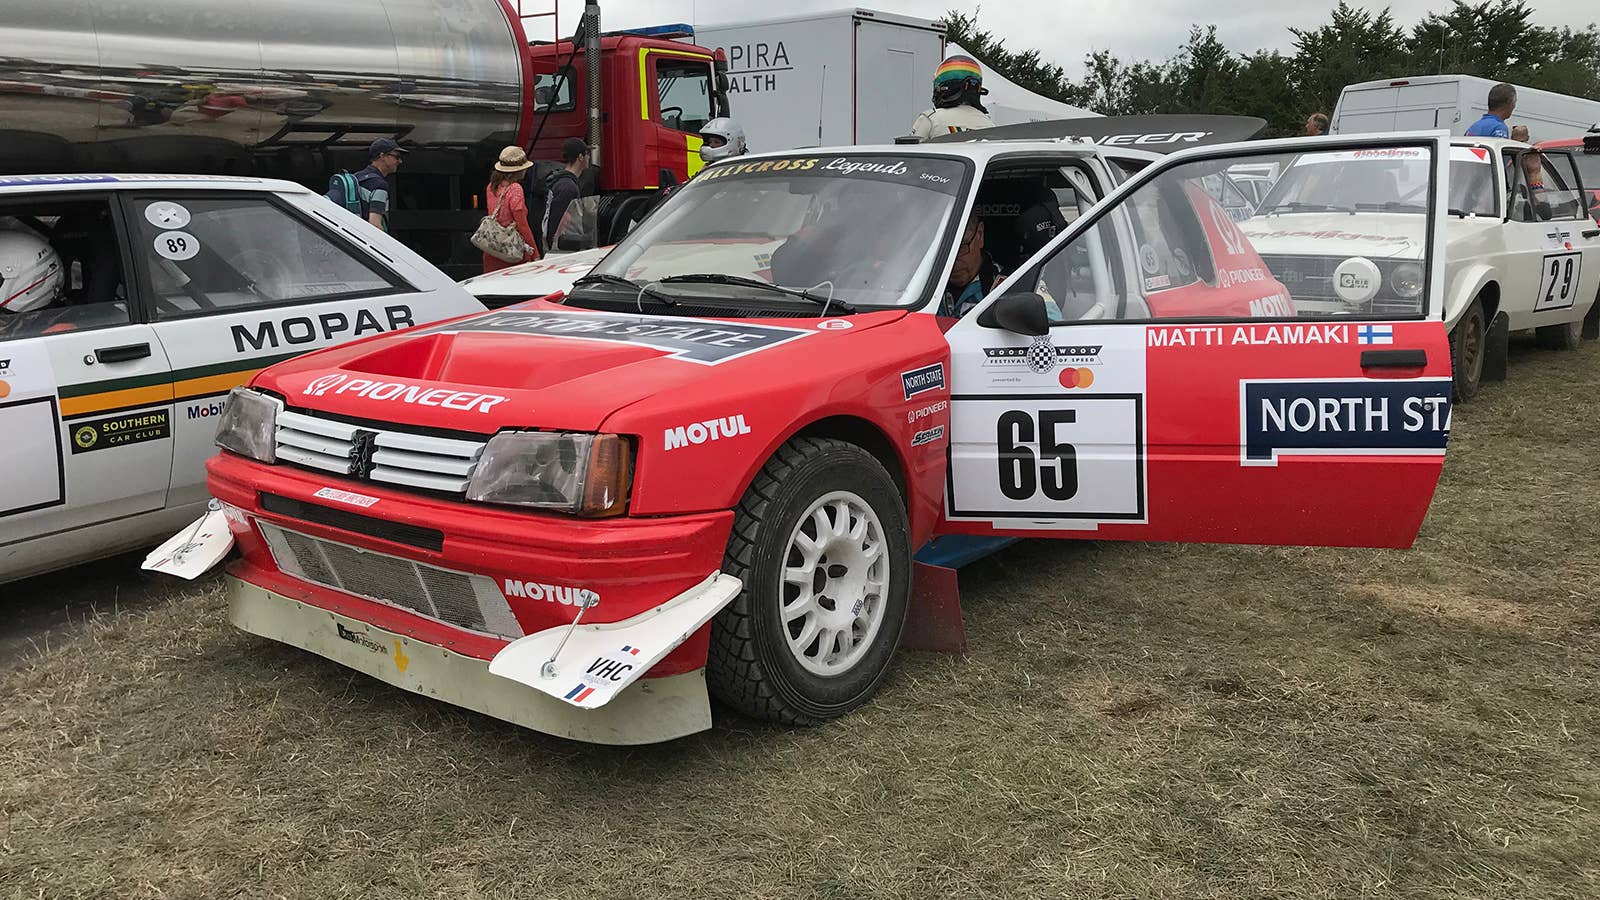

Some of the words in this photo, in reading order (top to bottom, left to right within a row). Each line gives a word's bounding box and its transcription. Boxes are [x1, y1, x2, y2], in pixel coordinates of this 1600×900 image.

[700, 74, 776, 95] WALTH
[821, 157, 907, 175] Legends
[920, 173, 951, 184] SHOW
[166, 237, 187, 253] 89
[1545, 258, 1573, 302] 29
[230, 304, 415, 352] MOPAR
[605, 325, 766, 347] STATE
[1147, 328, 1223, 347] MATTI
[1231, 325, 1350, 346] ALAMAKI
[1059, 347, 1097, 355] WOOD
[905, 374, 926, 390] NORTH
[926, 369, 942, 384] STATE
[335, 378, 512, 414] PIONEER
[915, 400, 948, 420] PIONEER
[1261, 397, 1389, 432] NORTH
[102, 413, 166, 433] SOUTHERN
[664, 414, 752, 451] MOTUL
[109, 434, 131, 444] CAR
[135, 429, 162, 440] CLUB
[996, 409, 1079, 501] 65
[586, 656, 633, 682] VHC
